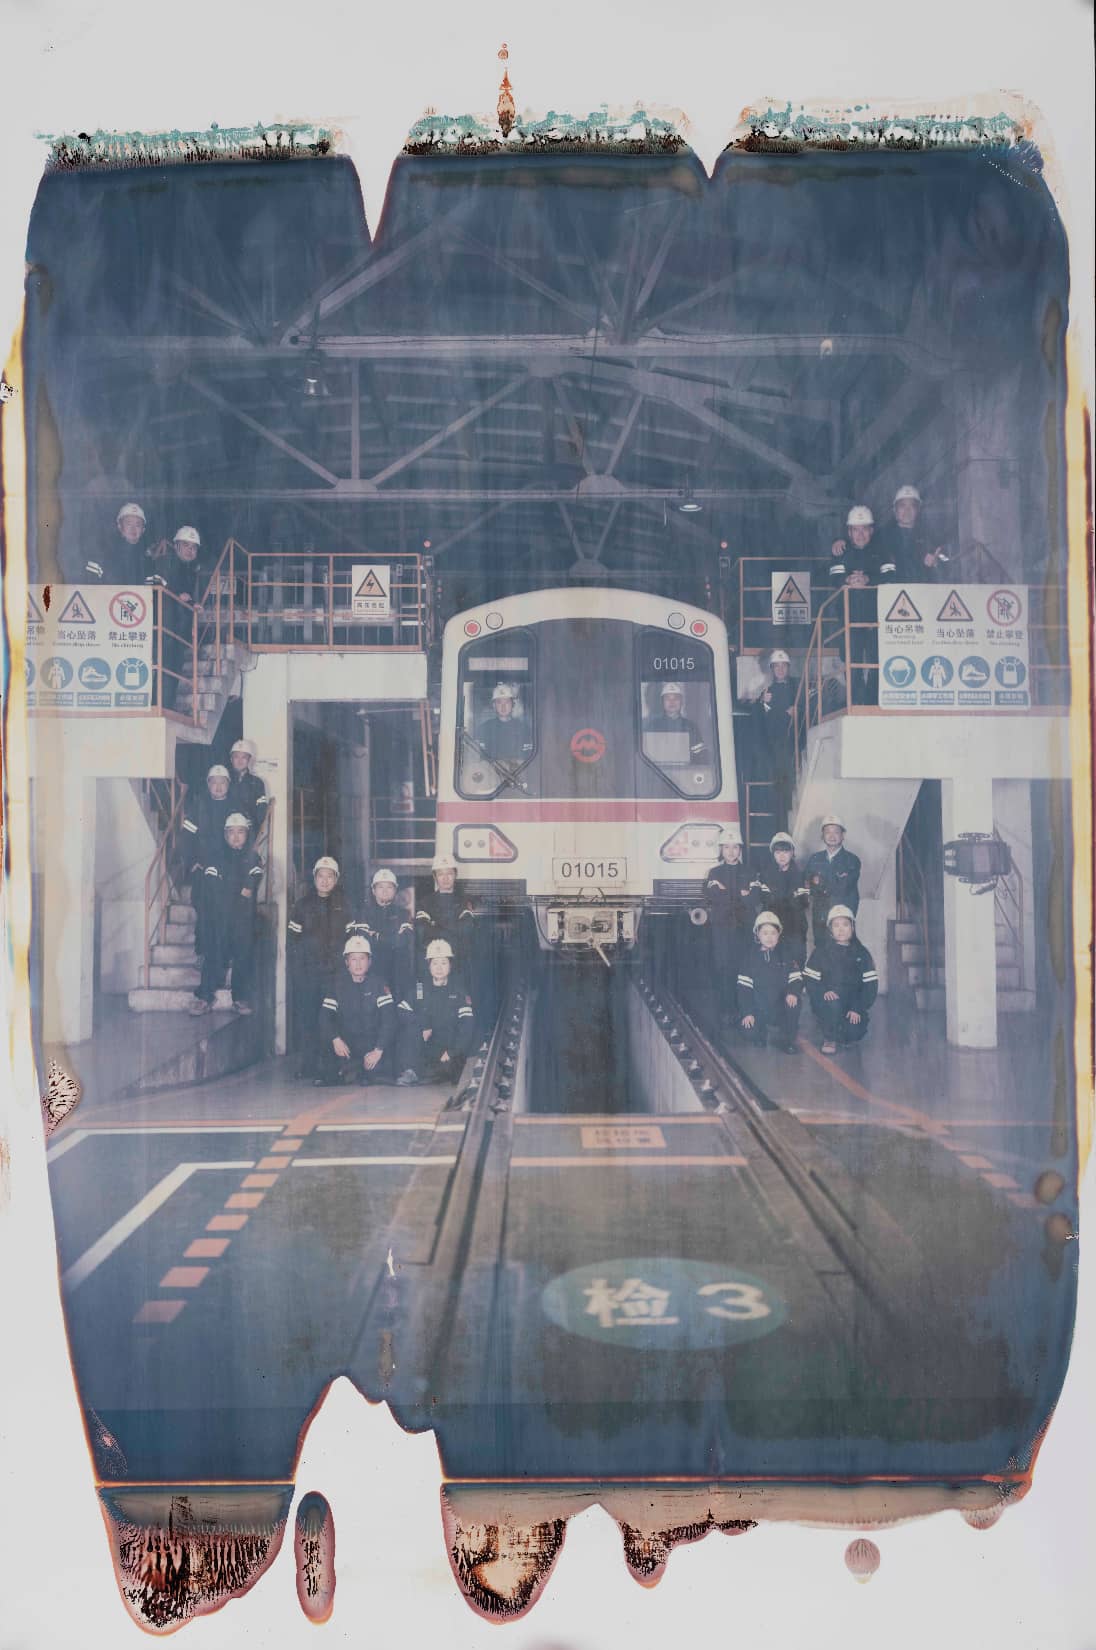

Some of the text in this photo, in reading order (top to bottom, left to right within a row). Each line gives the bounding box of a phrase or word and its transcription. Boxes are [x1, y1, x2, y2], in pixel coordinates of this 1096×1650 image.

[57, 630, 97, 641] 当心坠落
[108, 631, 148, 641] 禁止攀登
[936, 628, 975, 639] 当心坠落
[986, 629, 1025, 640] 禁止攀登
[653, 657, 695, 670] 01015
[561, 862, 618, 878] 01015
[583, 1278, 772, 1328] 检 3
